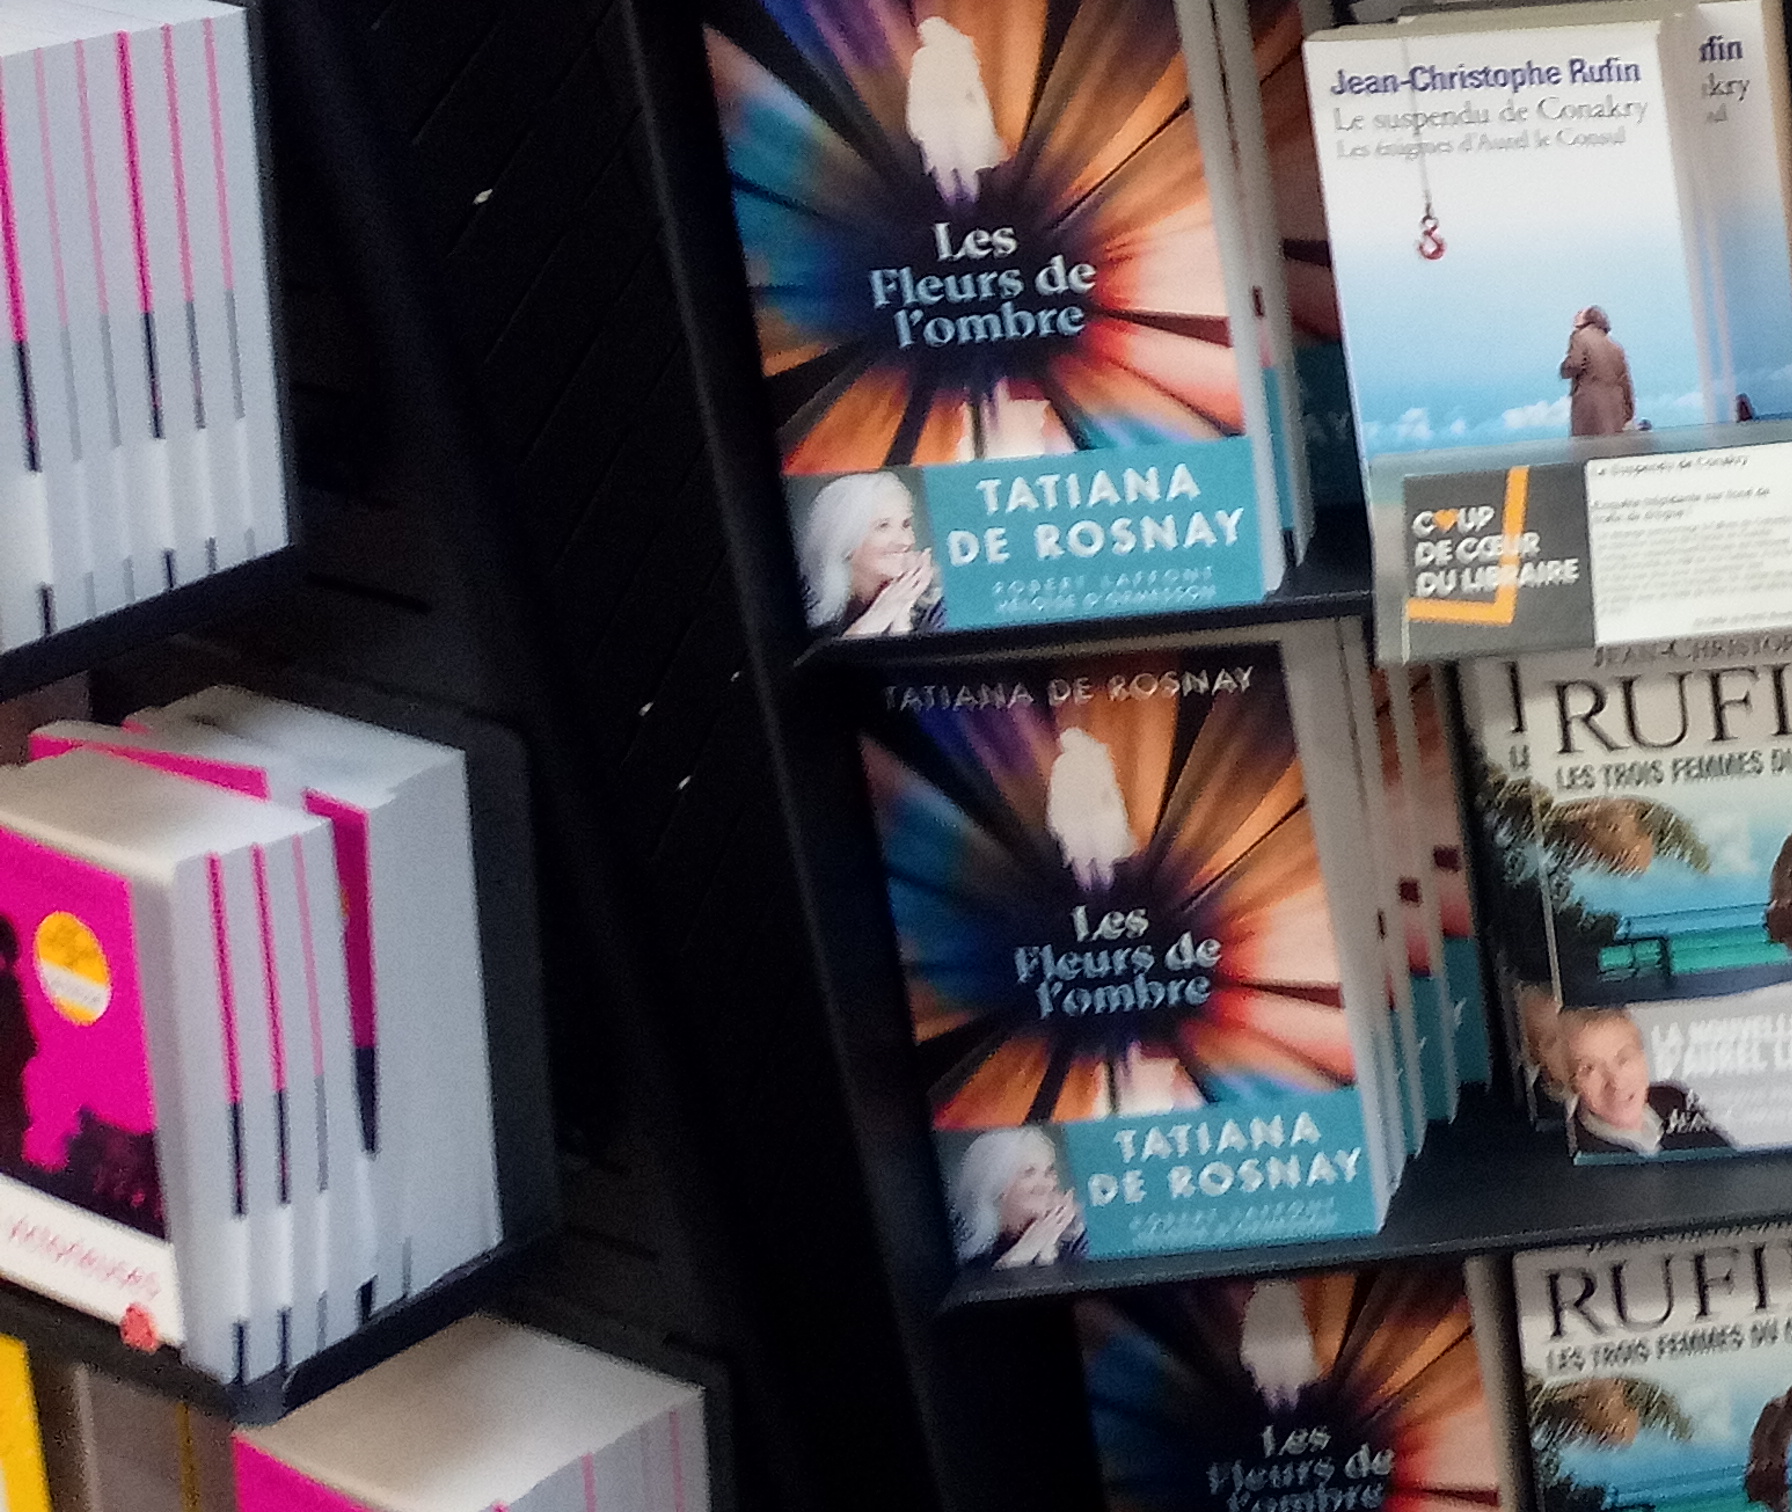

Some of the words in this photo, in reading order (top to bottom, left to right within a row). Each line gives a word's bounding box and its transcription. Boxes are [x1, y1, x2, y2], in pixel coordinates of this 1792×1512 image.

[1330, 59, 1561, 98] Jean-Christophe
[1569, 57, 1640, 84] Rufin
[1334, 107, 1365, 133] Le
[1374, 100, 1490, 133] suspendu
[1498, 98, 1529, 123] de
[1536, 96, 1648, 126] Conakry
[934, 222, 1018, 262] Les
[869, 267, 1024, 309] Fleurs
[1035, 254, 1096, 293] de
[976, 463, 1200, 517] TATIANA
[946, 529, 1009, 568] DE
[1035, 507, 1245, 560] ROSNAY
[1418, 569, 1458, 596] DU
[1464, 558, 1579, 592] LIBRAIRE
[1072, 904, 1149, 942] Les
